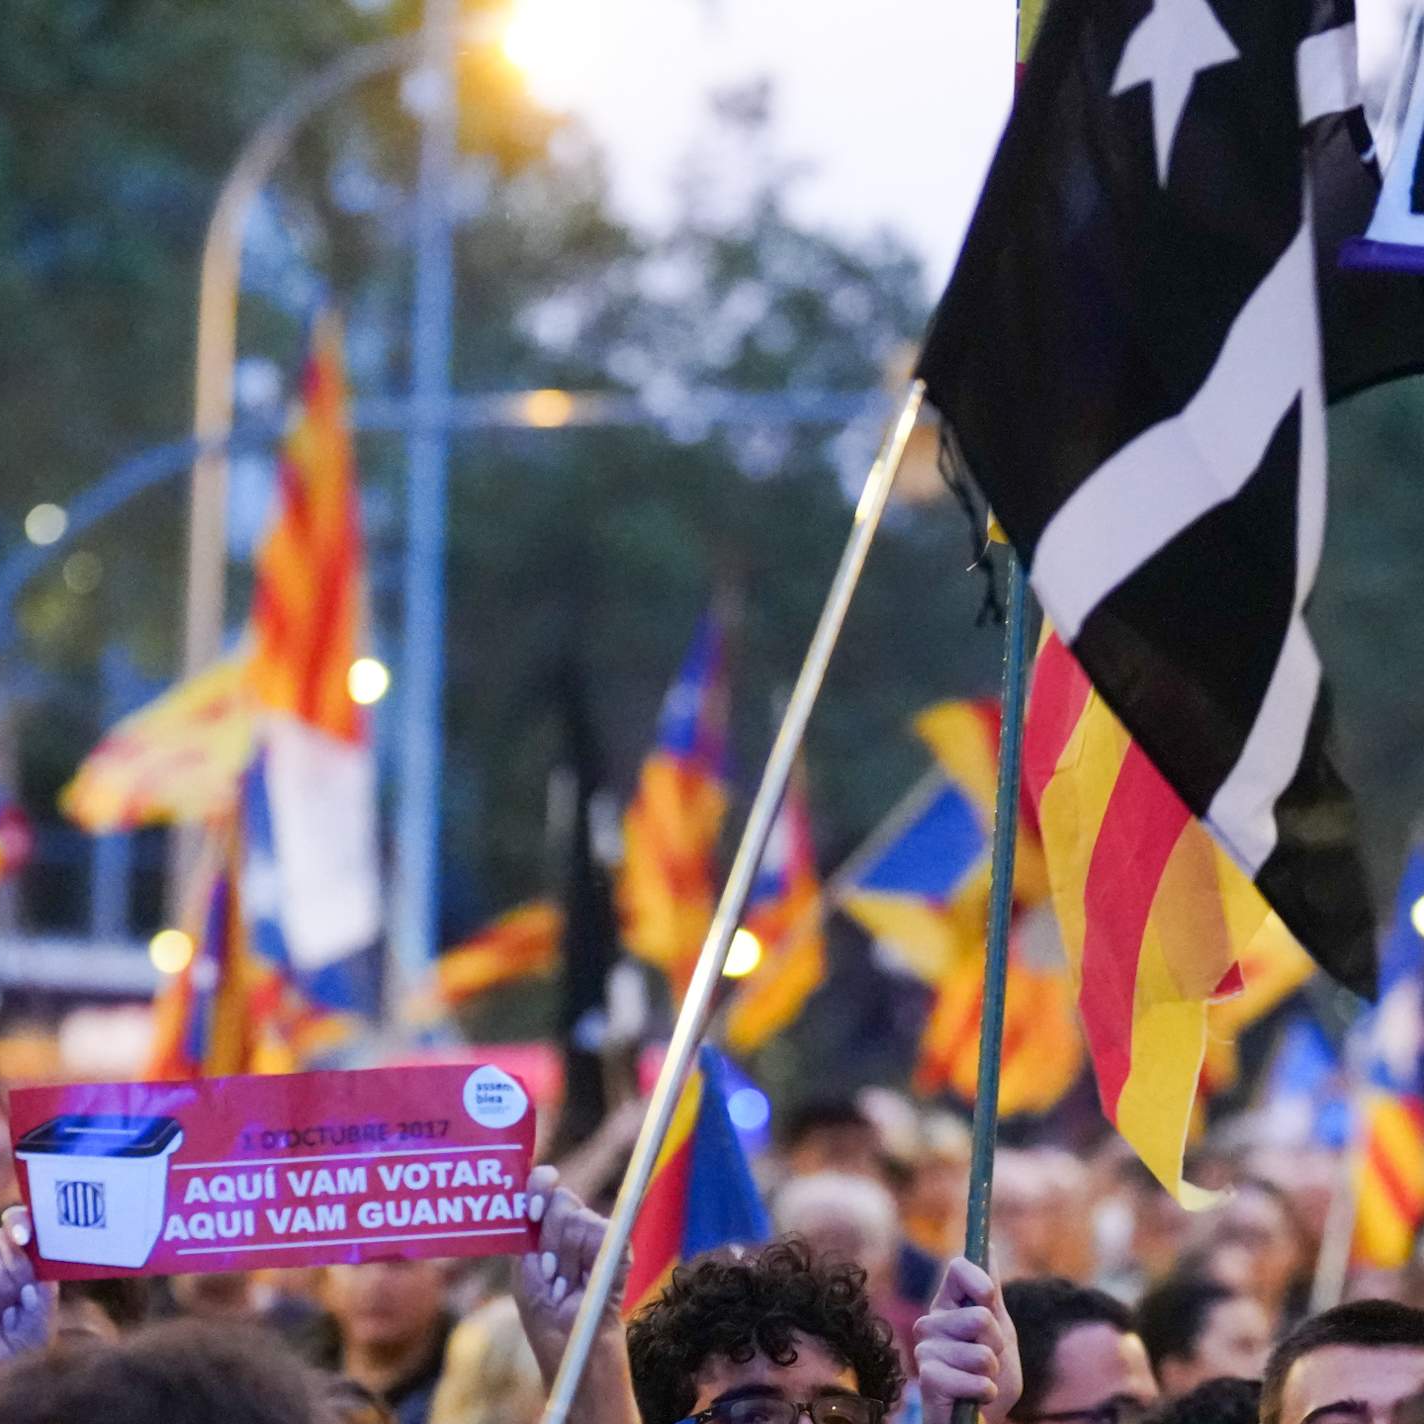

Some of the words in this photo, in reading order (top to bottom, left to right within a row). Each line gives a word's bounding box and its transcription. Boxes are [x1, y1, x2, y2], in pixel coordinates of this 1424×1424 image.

[396, 1120, 449, 1142] 2017
[183, 1167, 275, 1205] AQUÍ
[287, 1167, 367, 1198] VAM
[377, 1158, 513, 1192] VOTAR,
[266, 1203, 347, 1234] VAM
